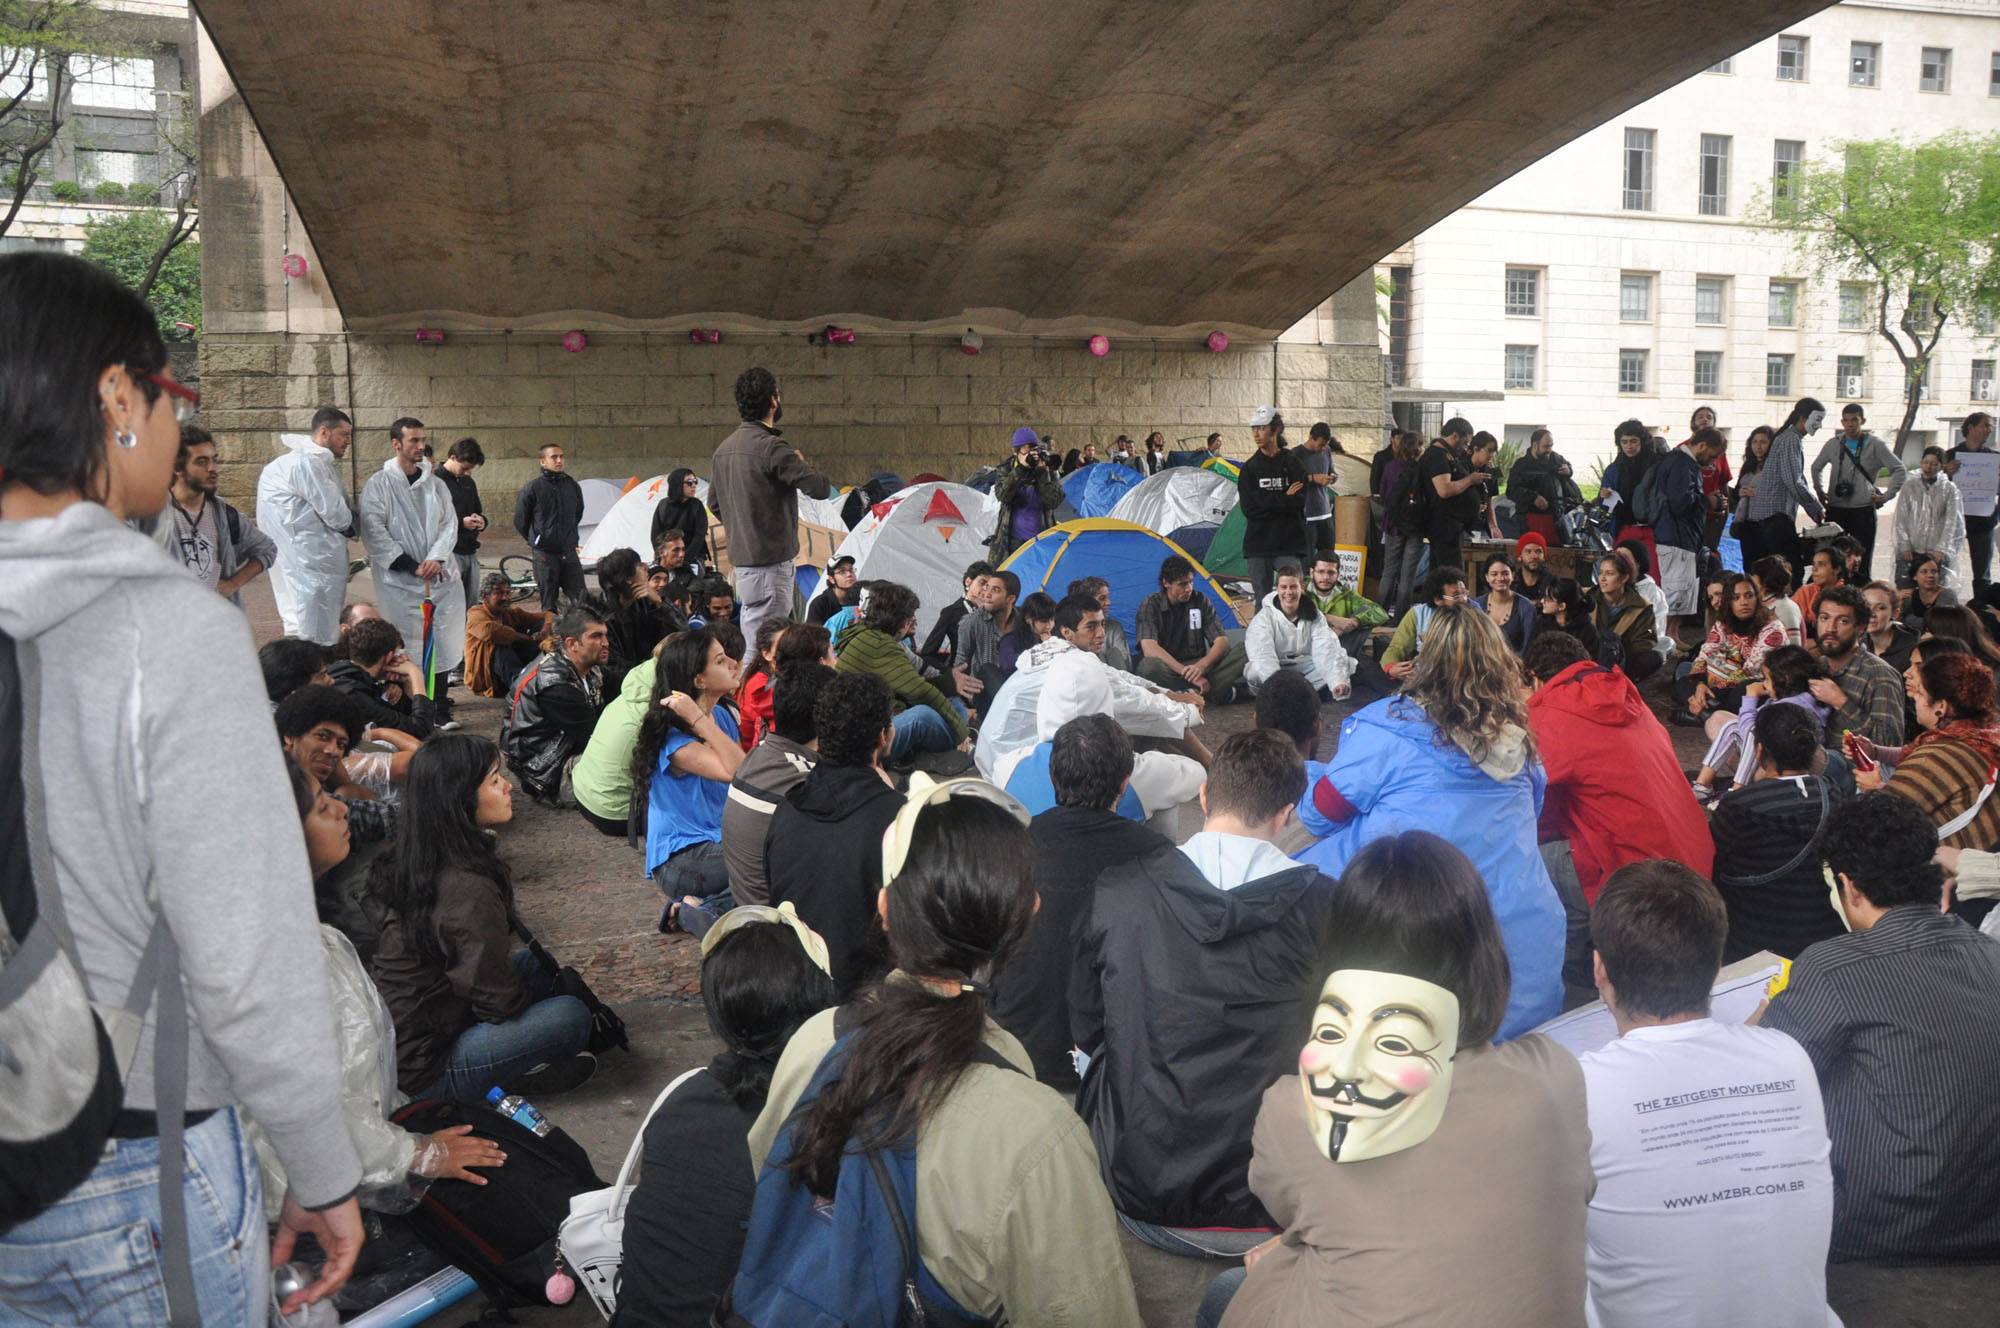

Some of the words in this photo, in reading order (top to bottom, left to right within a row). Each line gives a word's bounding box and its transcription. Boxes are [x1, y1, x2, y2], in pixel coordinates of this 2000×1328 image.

[1633, 1099, 1662, 1112] THE
[1663, 1087, 1725, 1107] ZEITGEIST
[1728, 1079, 1796, 1096] MOVEMENT
[1663, 1180, 1806, 1209] WWW.MZBR.COM.BR
